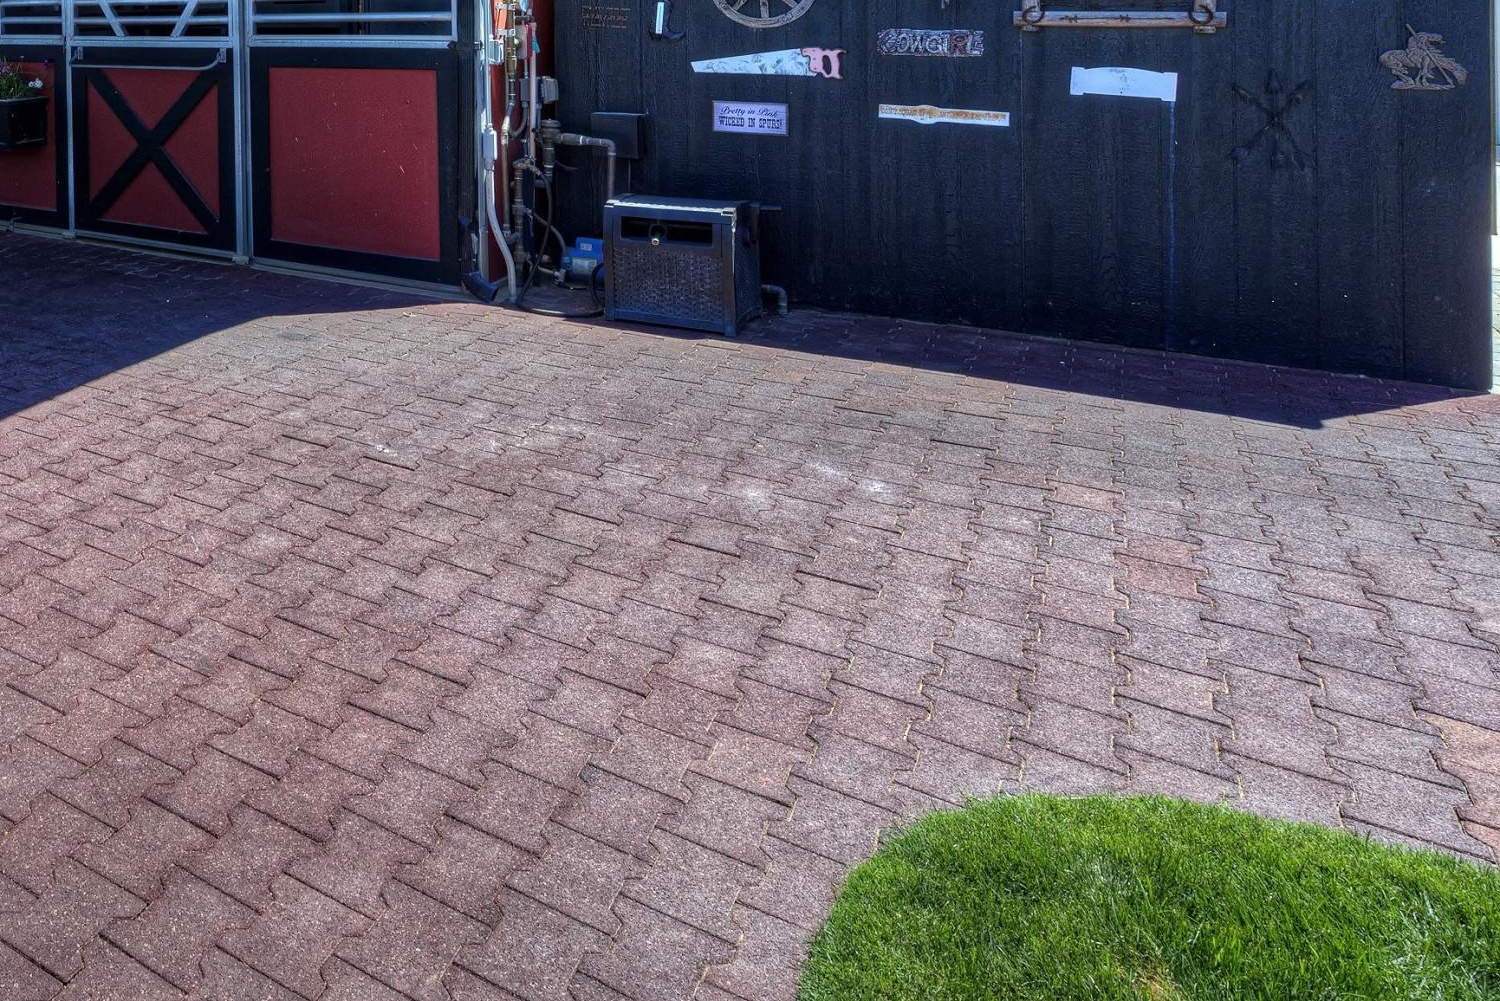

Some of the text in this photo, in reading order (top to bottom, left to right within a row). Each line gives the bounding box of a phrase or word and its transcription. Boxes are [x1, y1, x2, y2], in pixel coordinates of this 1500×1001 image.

[721, 106, 746, 116] Pretty
[757, 108, 779, 118] Pink
[719, 116, 783, 129] WICKED IN SPURS!
